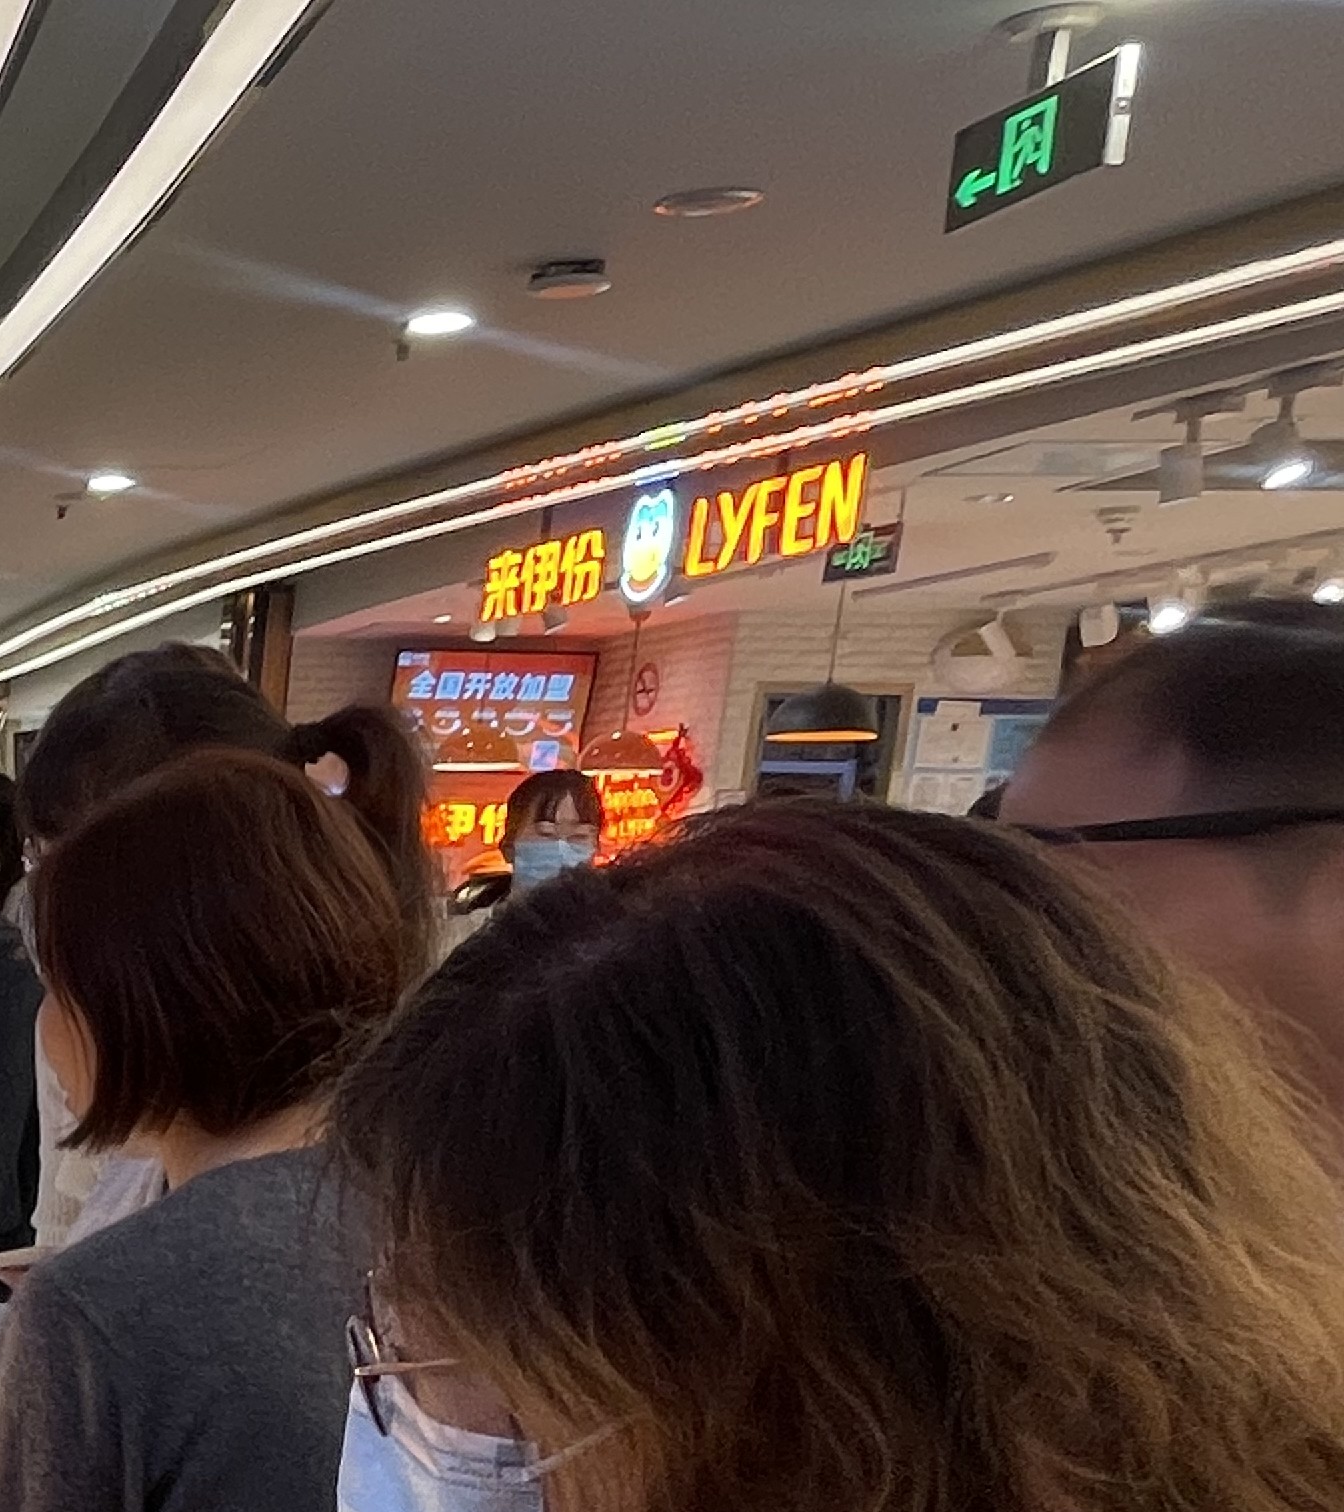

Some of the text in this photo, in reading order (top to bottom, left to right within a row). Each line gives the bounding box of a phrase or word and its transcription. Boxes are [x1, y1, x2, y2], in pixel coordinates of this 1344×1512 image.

[683, 452, 868, 578] LYFEN
[480, 528, 607, 623] 来伊份
[407, 670, 575, 700] 全国开放加盟
